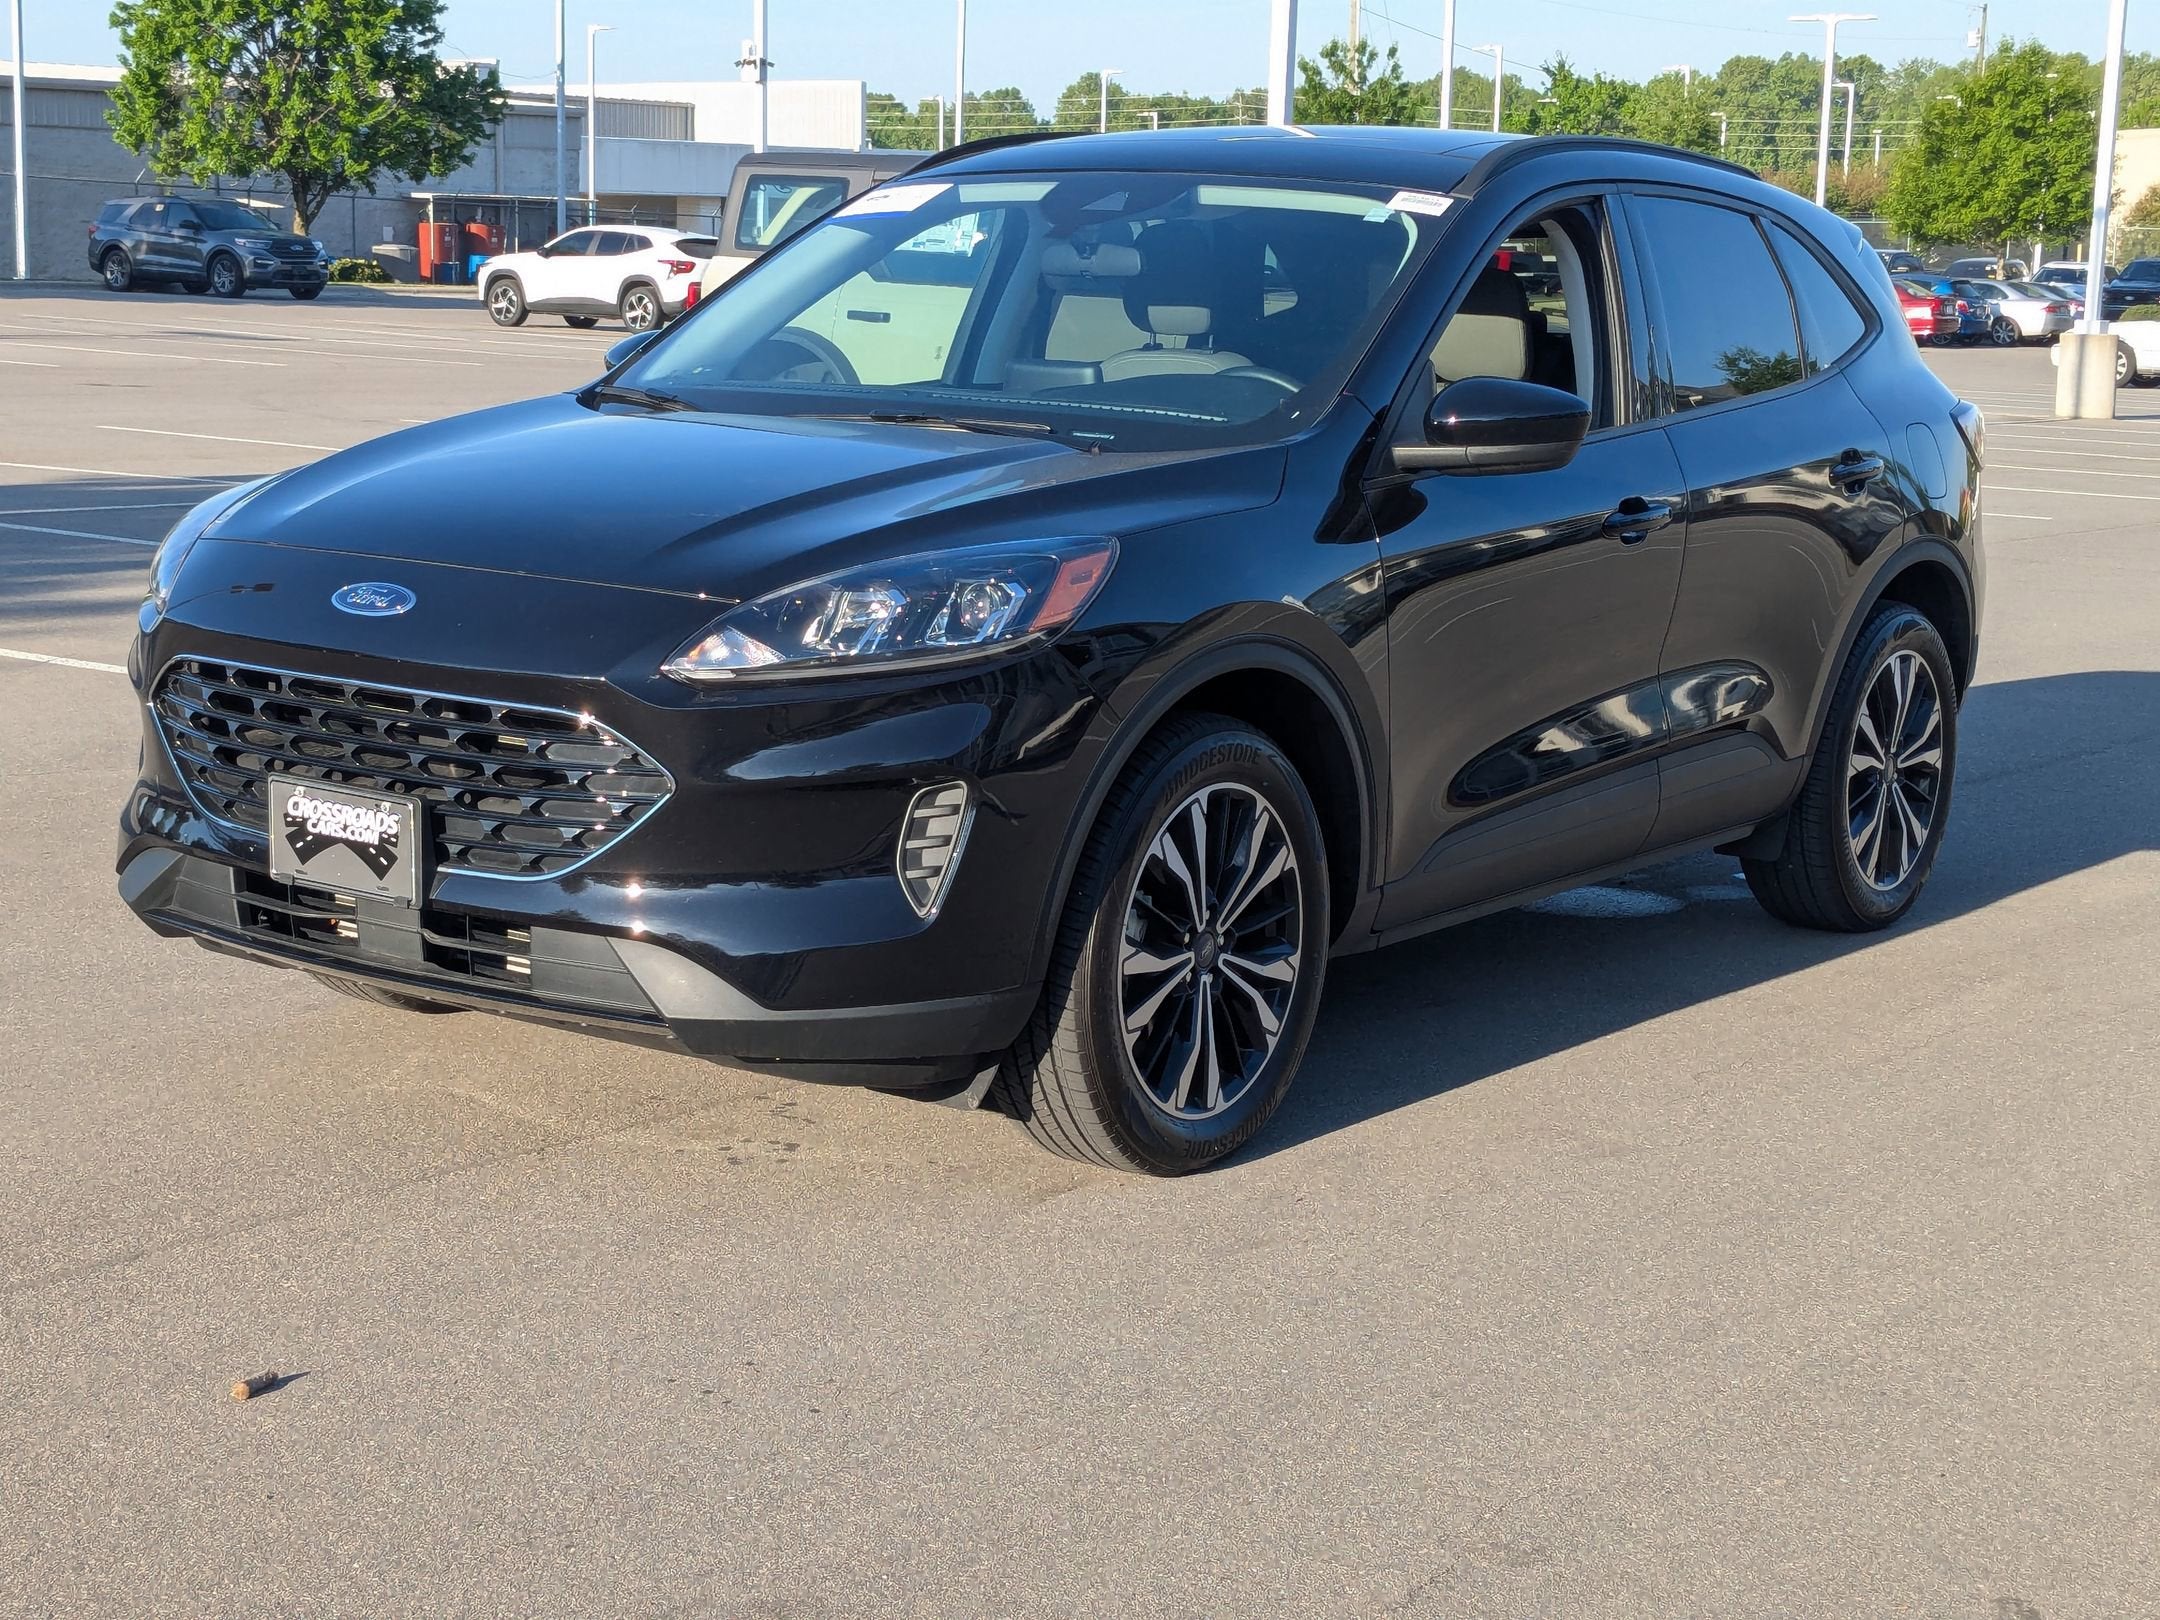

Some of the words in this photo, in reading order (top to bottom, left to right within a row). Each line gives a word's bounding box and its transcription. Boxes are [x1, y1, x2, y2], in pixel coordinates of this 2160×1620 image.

[346, 586, 396, 607] Ford
[1164, 742, 1262, 803] BRIDGESTONE
[286, 795, 400, 835] CROSSROADS
[306, 818, 380, 845] CARS.COM
